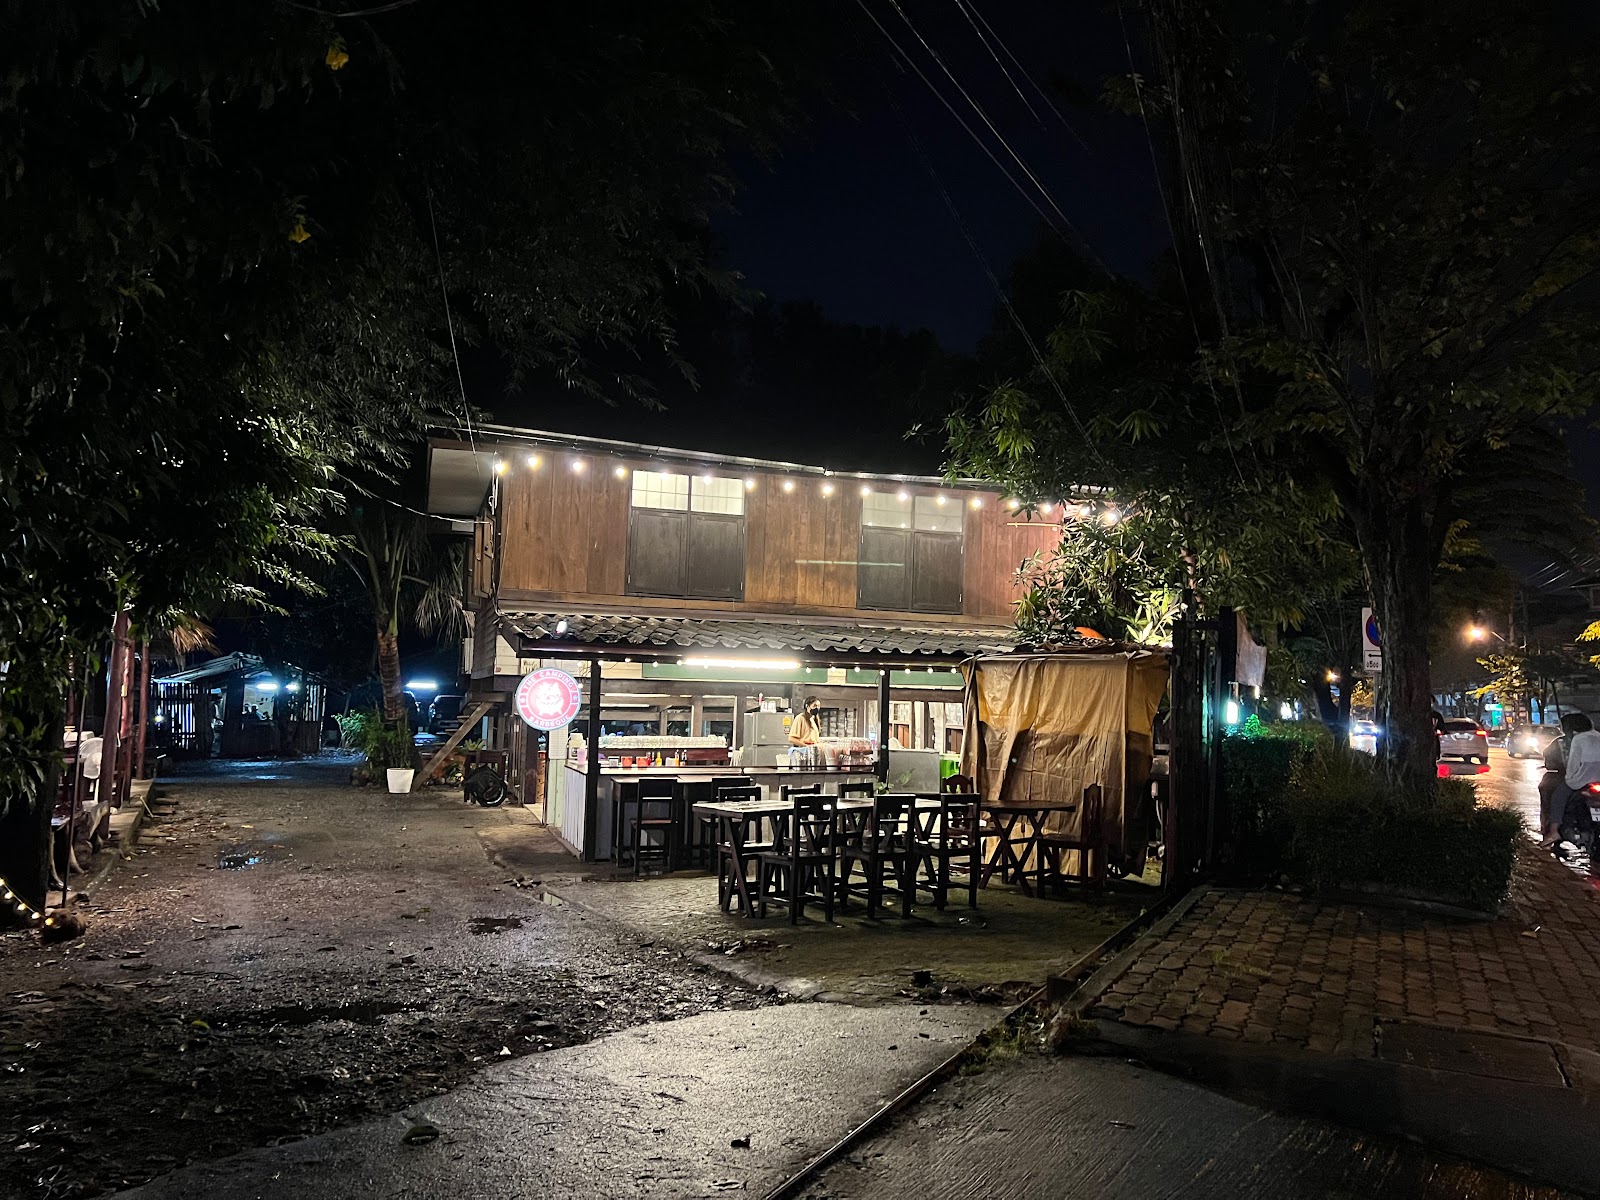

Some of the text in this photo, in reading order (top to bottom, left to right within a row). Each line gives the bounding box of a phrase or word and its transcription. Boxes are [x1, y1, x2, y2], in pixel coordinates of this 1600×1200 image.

[523, 670, 573, 690] THE CAMPING
[528, 714, 570, 727] BARBEQUE
